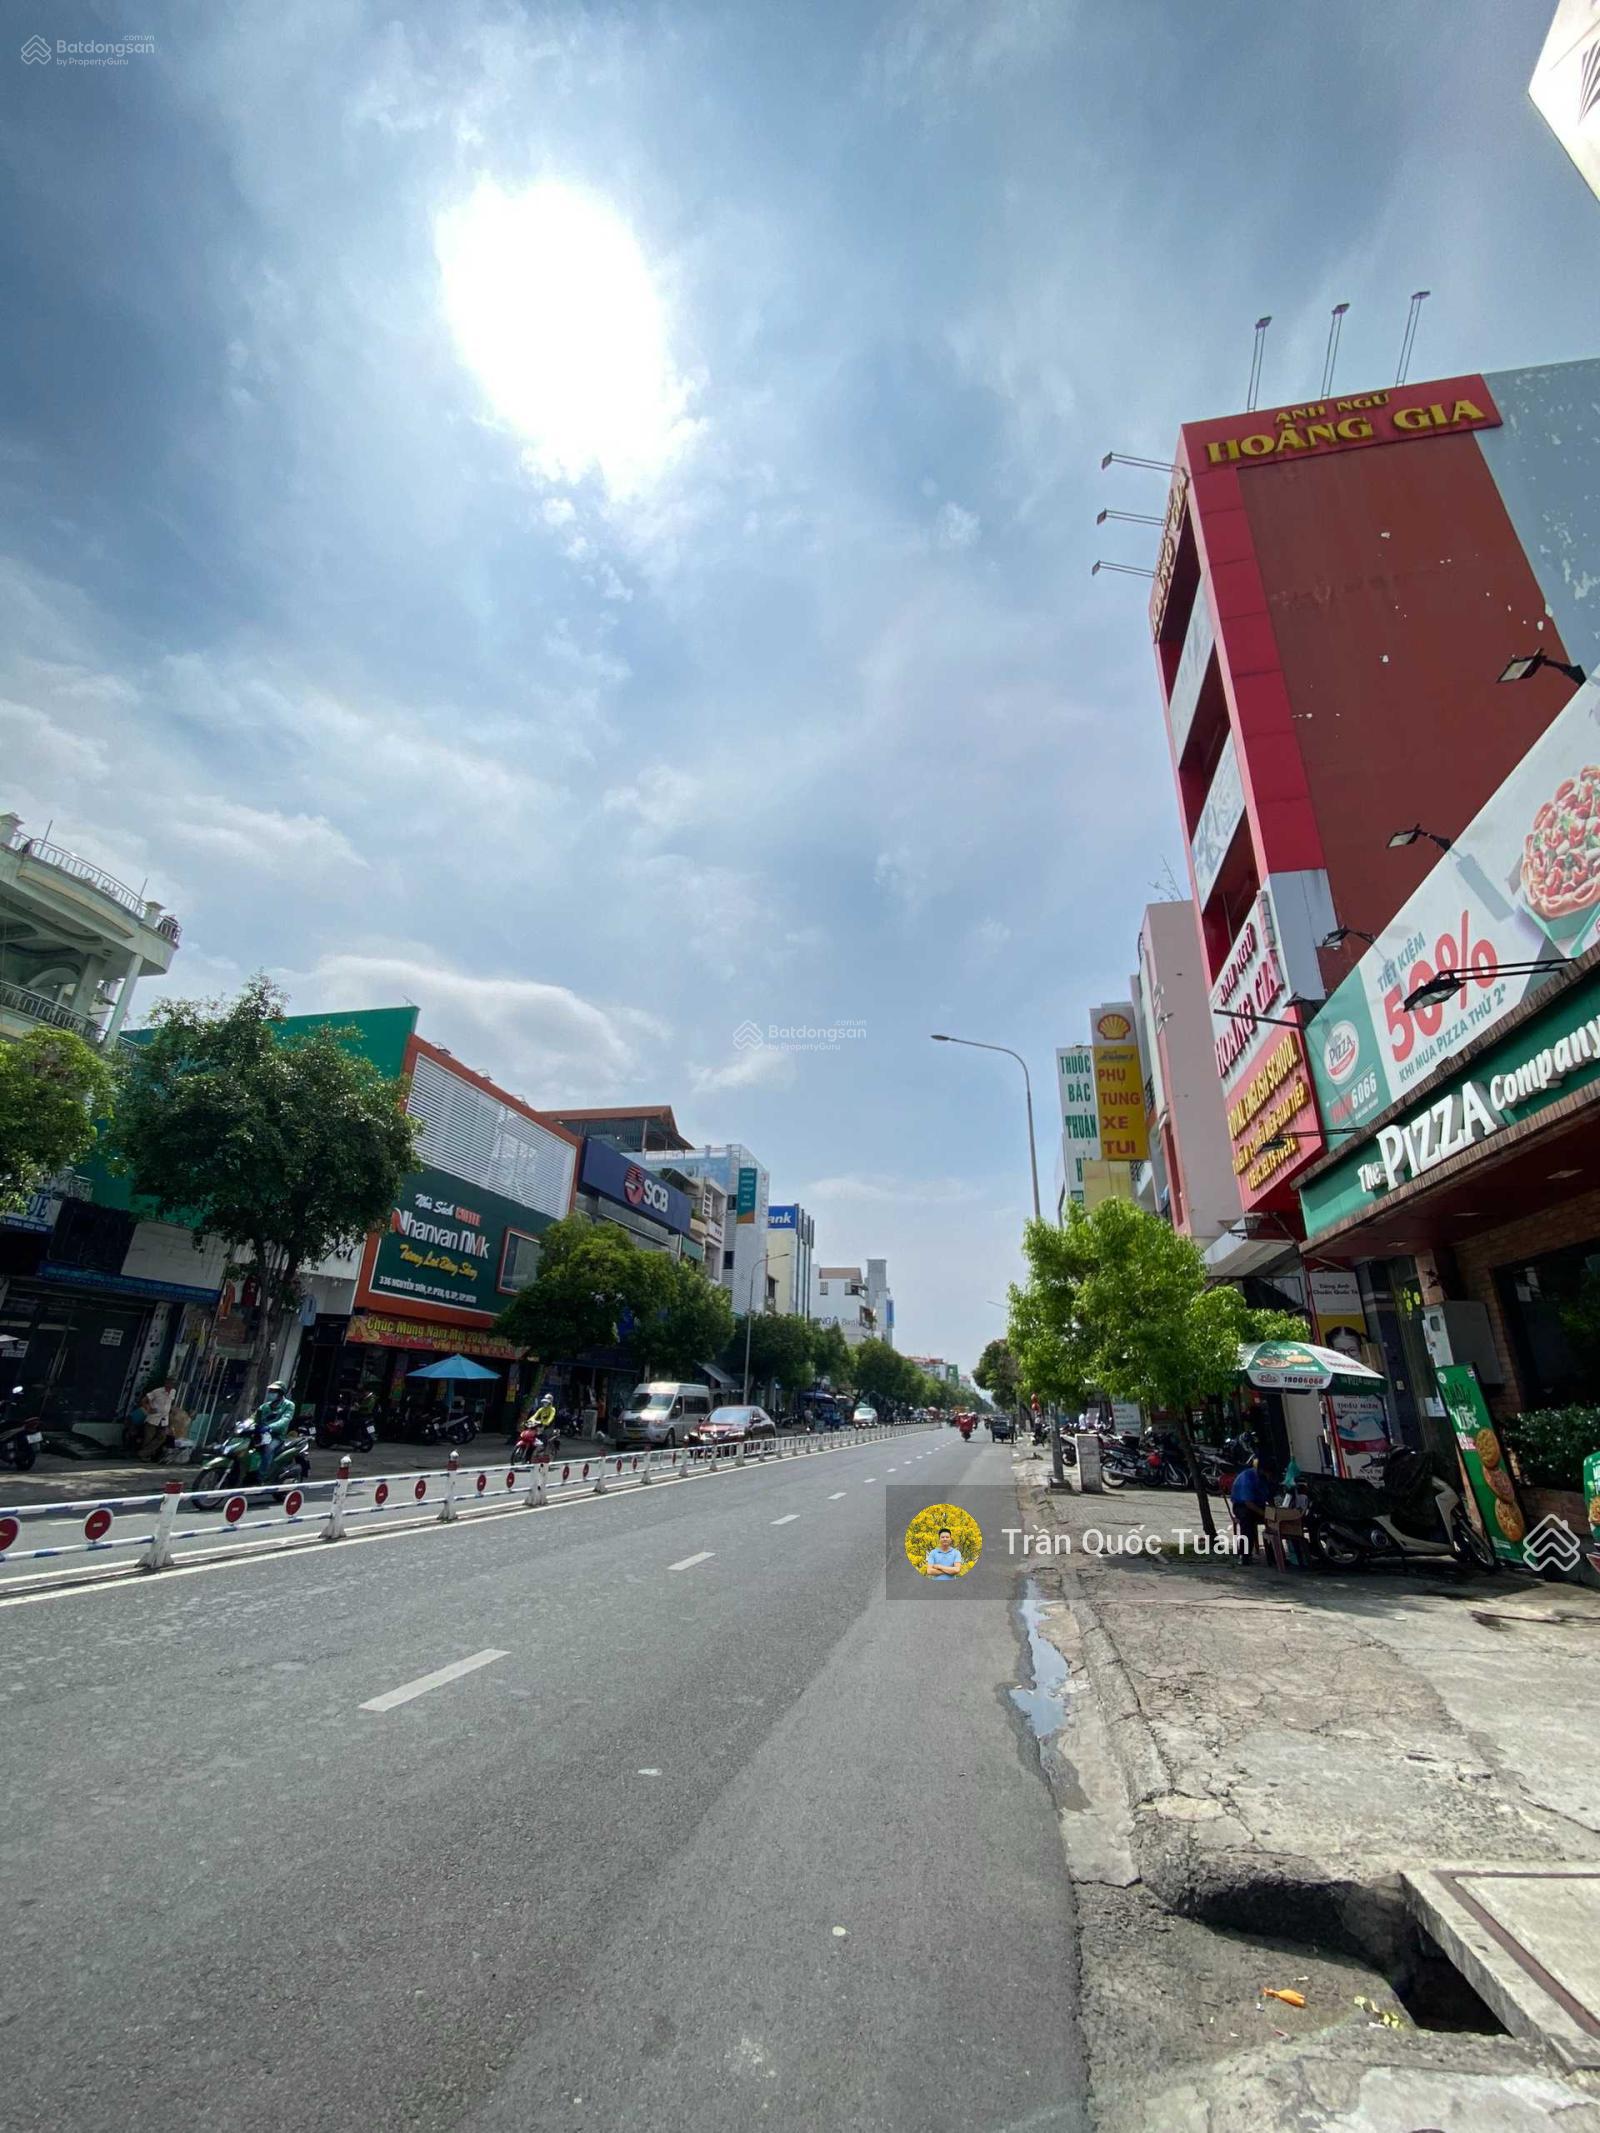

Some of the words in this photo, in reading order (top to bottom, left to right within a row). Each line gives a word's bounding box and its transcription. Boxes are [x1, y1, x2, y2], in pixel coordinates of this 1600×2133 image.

[1206, 417, 1375, 464] HOÀNG
[1392, 399, 1487, 430] GIA
[1274, 405, 1325, 424] ANH
[1254, 949, 1285, 1014] GIA
[1377, 960, 1398, 992] TIẾT
[1397, 932, 1426, 972] KIỆM
[1384, 910, 1498, 1063] 50%
[1060, 1049, 1091, 1074] THUỐC
[1399, 1066, 1415, 1083] KHI
[1416, 1047, 1437, 1069] MUA
[1436, 1020, 1469, 1053] PIZZA
[1469, 993, 1492, 1028] THỨ
[1098, 1069, 1126, 1086] PHỤ
[1244, 1064, 1272, 1116] ENGLISH
[1267, 1031, 1300, 1091] SCHOOL
[1103, 1116, 1129, 1130] XE
[1376, 1081, 1498, 1191] PIZZA
[433, 1200, 455, 1216] Sách
[643, 1179, 669, 1213] SCB
[366, 1314, 393, 1331] Chúc
